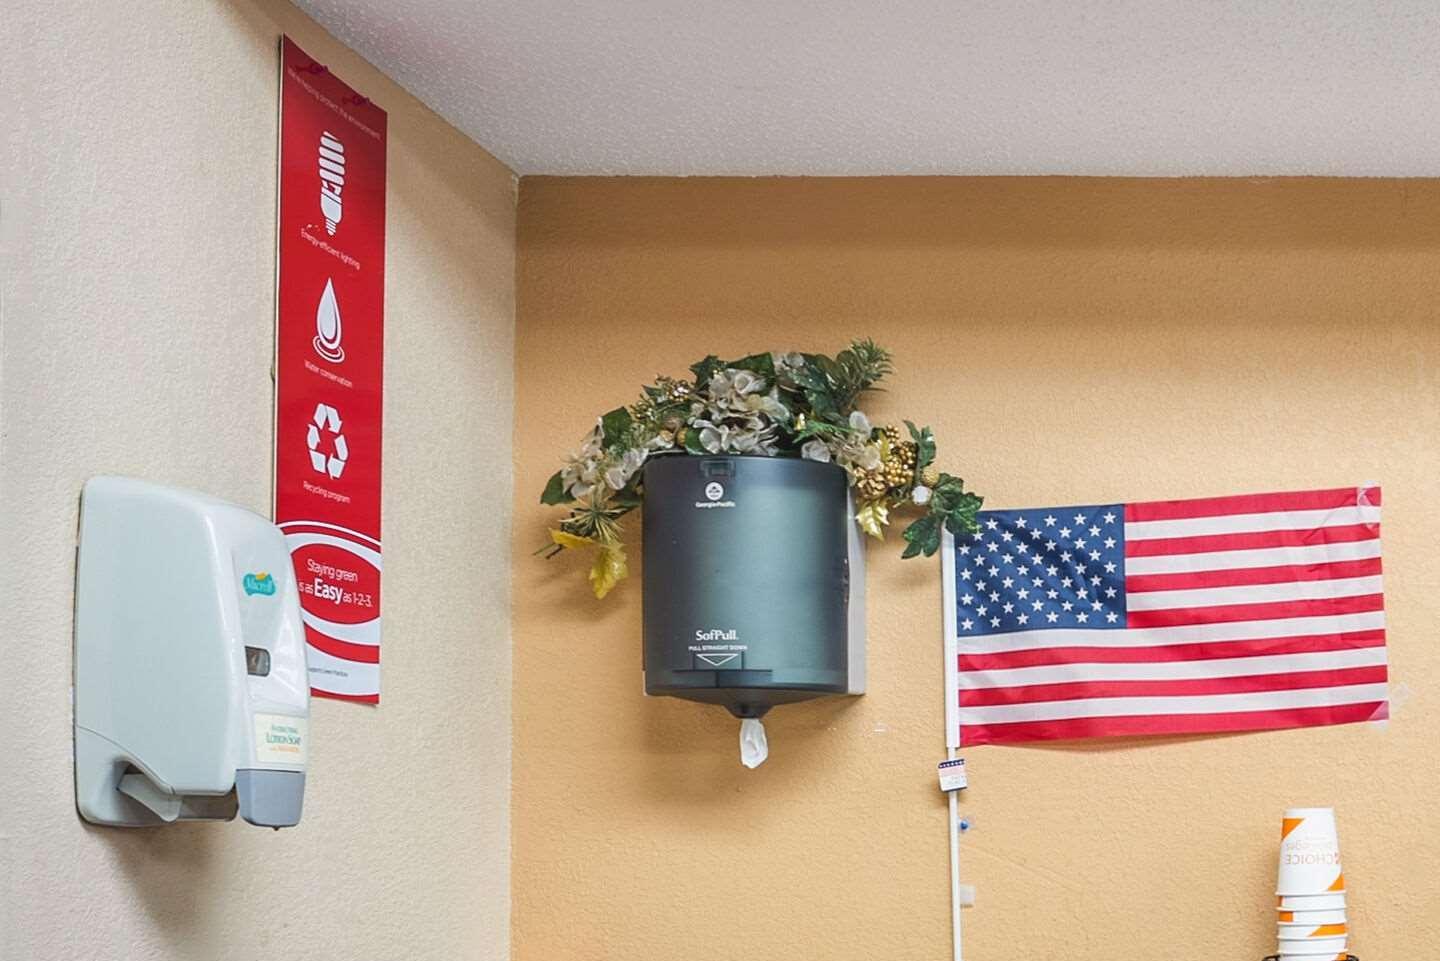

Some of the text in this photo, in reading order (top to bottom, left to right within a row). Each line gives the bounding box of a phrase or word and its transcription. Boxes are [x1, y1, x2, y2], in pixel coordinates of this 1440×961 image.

[307, 558, 359, 583] Staying green
[314, 577, 343, 605] Easy
[695, 629, 736, 641] SofPull
